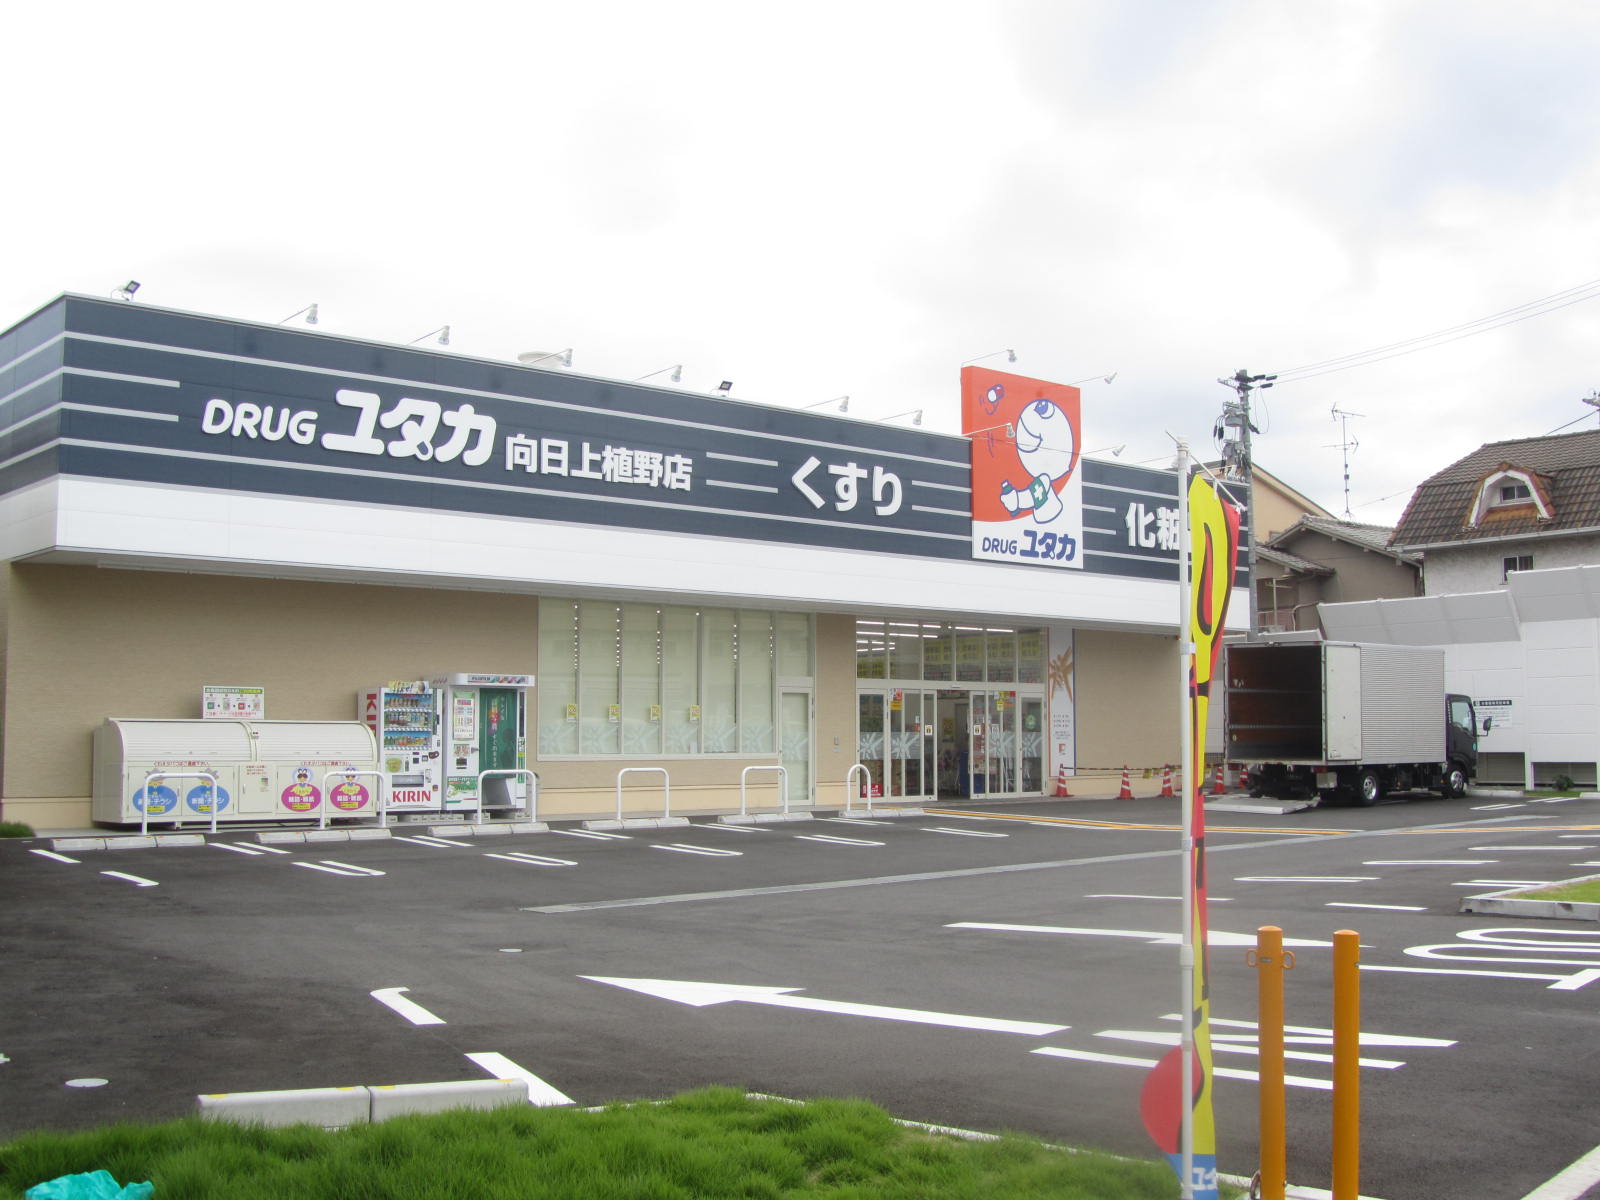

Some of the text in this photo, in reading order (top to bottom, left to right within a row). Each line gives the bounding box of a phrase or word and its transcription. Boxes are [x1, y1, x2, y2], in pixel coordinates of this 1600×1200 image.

[201, 389, 497, 466] DRUG ユタカ
[505, 433, 693, 491] 向日上植野店
[791, 456, 903, 516] くすり
[982, 529, 1077, 561] DRUG ユタカ
[1125, 502, 1192, 551] 化粧
[392, 790, 432, 803] KIRIN
